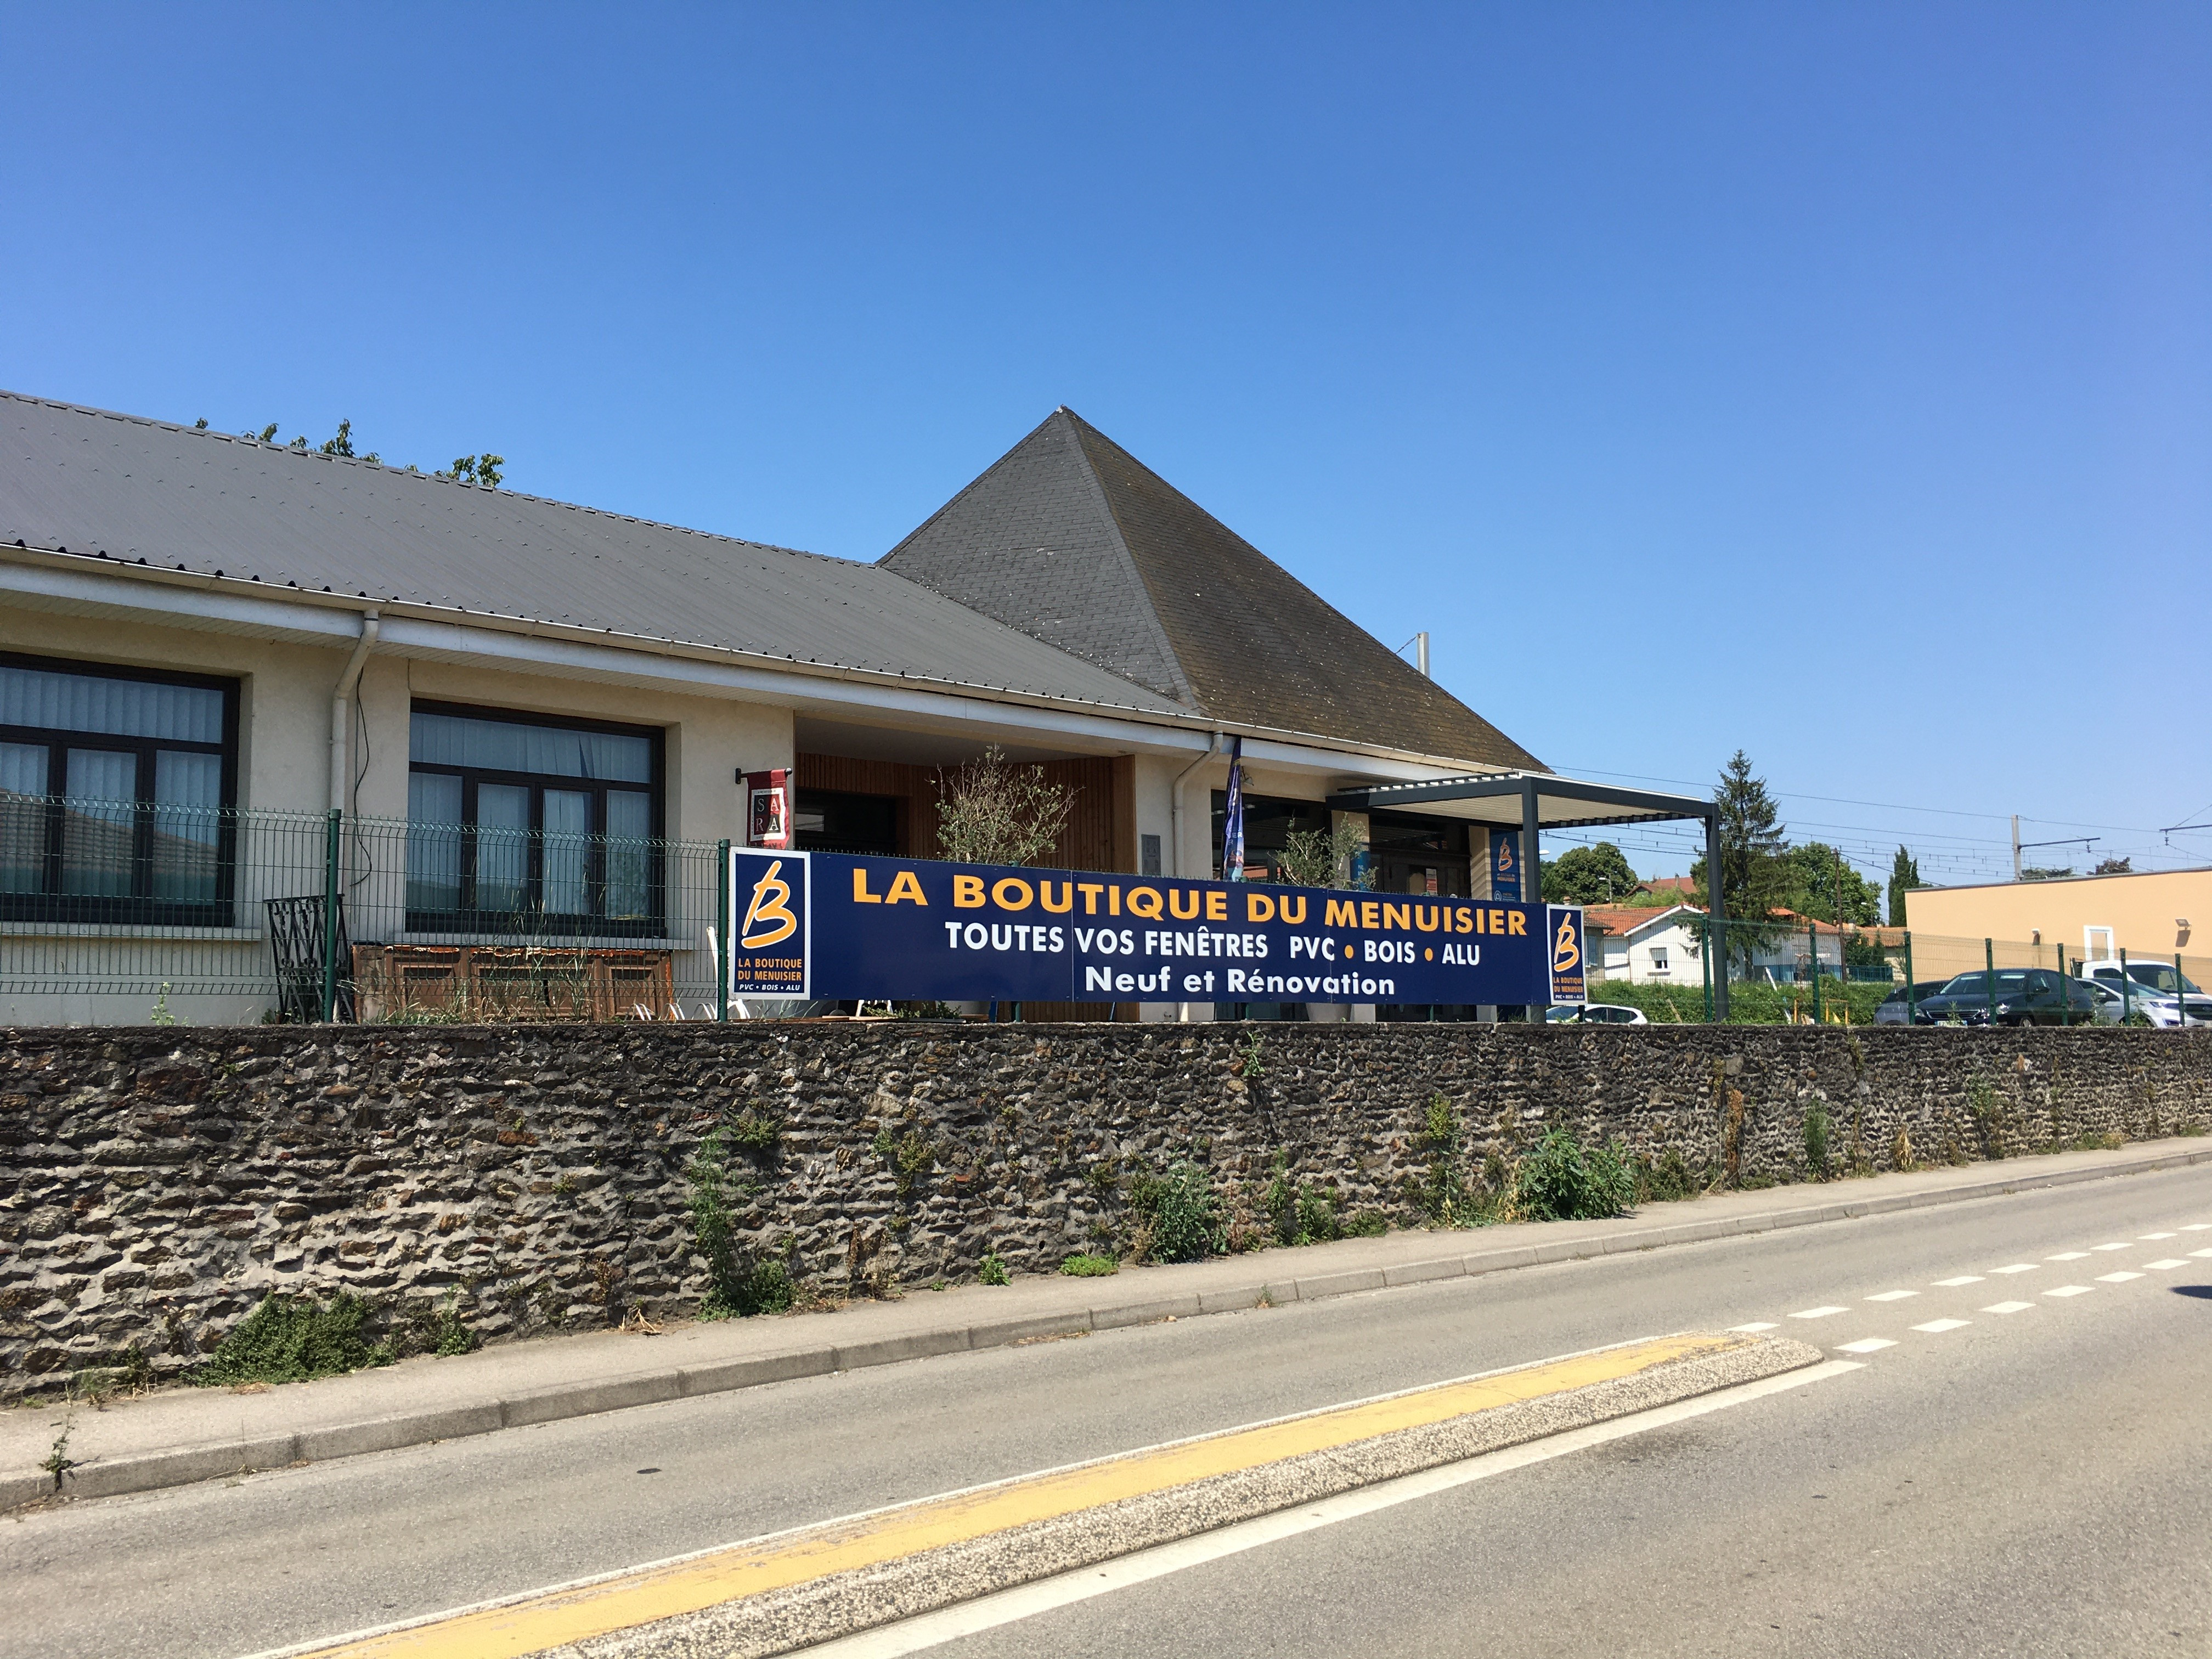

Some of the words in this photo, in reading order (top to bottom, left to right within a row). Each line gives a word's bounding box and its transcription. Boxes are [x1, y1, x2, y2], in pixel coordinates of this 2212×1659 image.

[853, 868, 928, 906] LA
[953, 874, 1227, 921] BOUTIQUE
[1247, 893, 1306, 924] DU
[1325, 899, 1527, 935] MENUISIER
[945, 922, 1064, 953] TOUTES
[1074, 927, 1134, 955] VOS
[1145, 926, 1268, 958] FENÊTRES
[1290, 936, 1335, 961] PVC
[1364, 940, 1415, 963] BOIS
[1441, 943, 1480, 966] ALU
[738, 958, 751, 968] LA
[755, 958, 802, 969] BOUTIQUE
[738, 970, 751, 980] DU
[754, 970, 802, 981] MENUISIER
[1086, 966, 1171, 992] Neuf
[1183, 970, 1215, 992] et
[1227, 968, 1395, 995] Rénovation
[1561, 977, 1583, 985] BOUTIQUE
